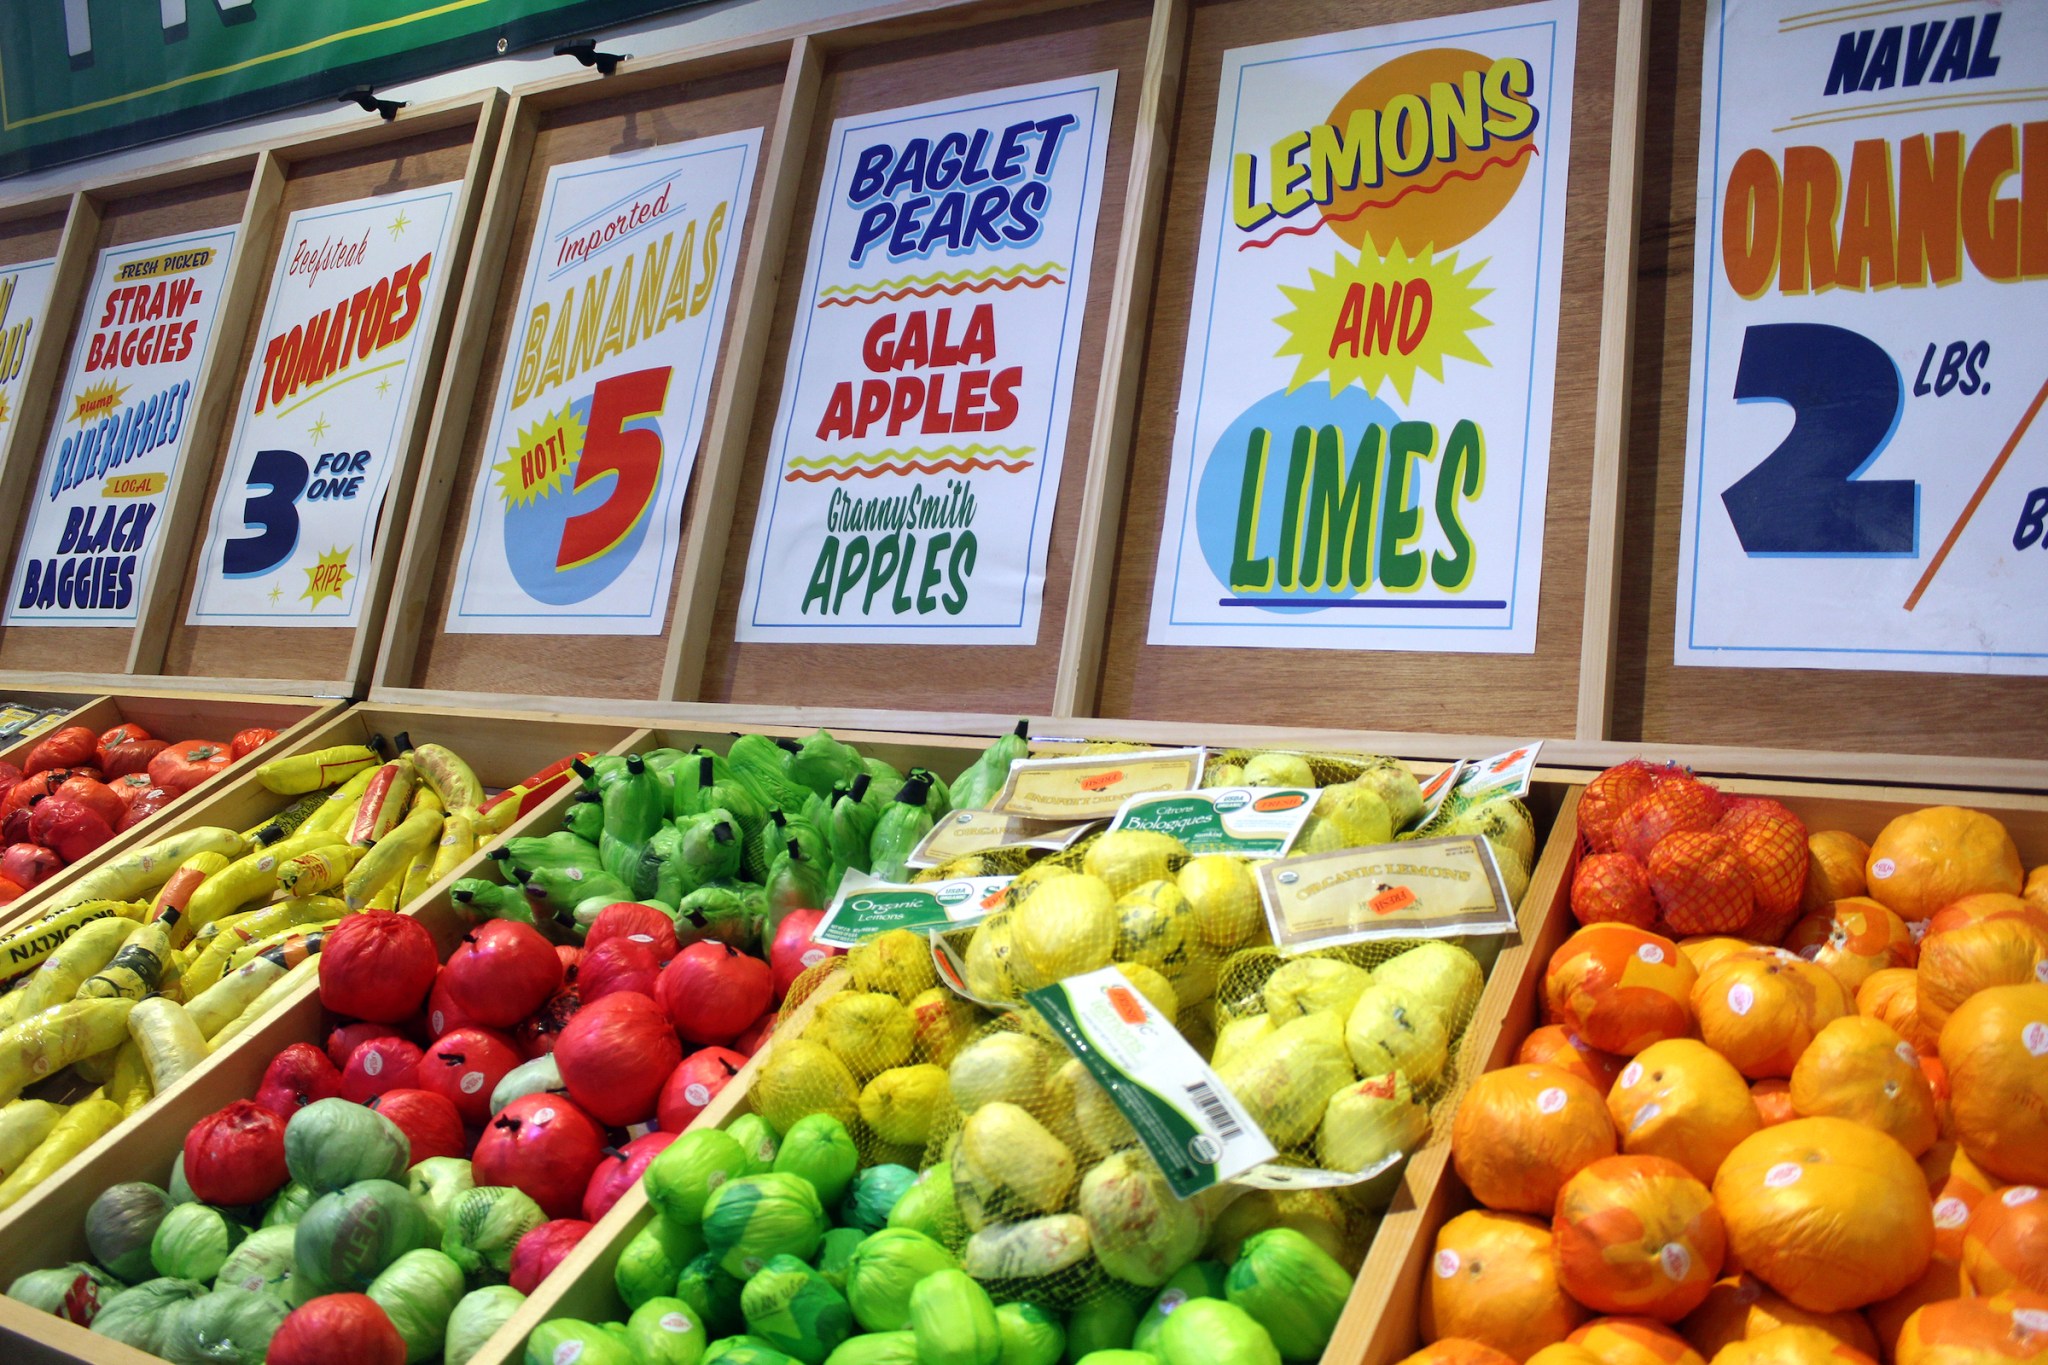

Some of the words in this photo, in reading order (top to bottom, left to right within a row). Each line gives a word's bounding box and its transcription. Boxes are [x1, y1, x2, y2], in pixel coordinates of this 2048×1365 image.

[1823, 12, 2002, 96] NAVAL
[847, 114, 1080, 208] BAGLET
[1232, 57, 1540, 232] LEMONS
[289, 227, 371, 289] Beefsteak
[557, 182, 671, 267] Imported
[848, 180, 1052, 269] PEARS
[121, 260, 158, 279] FRESH
[163, 251, 210, 272] PICKED
[100, 277, 203, 328] STRAW-
[254, 252, 432, 417] TOMATOES
[511, 201, 727, 411] BANANAS
[1328, 277, 1432, 359] AND
[84, 320, 198, 372] BAGGIES
[862, 303, 996, 373] GALA
[815, 366, 1023, 441] APPLES
[50, 379, 190, 502] BLUEBAGGIES
[521, 427, 566, 490] HOT!
[556, 366, 674, 573] 5
[1721, 323, 1921, 558] 2
[1913, 340, 1991, 397] LBS.
[114, 479, 152, 494] LOCAL
[222, 450, 309, 579] 3
[314, 450, 372, 476] FOR
[307, 476, 365, 501] ONE
[1229, 419, 1486, 593] LIMES
[57, 503, 156, 554] BLACK
[19, 555, 136, 610] BAGGIES
[312, 564, 347, 592] RIPE
[801, 530, 978, 616] APPLES
[1126, 814, 1213, 834] Biologiques
[1156, 805, 1194, 816] Citrons
[852, 898, 924, 914] Organic
[1295, 864, 1382, 901] ORGANIC
[1384, 862, 1471, 882] LEMONS
[858, 912, 905, 922] Lemons
